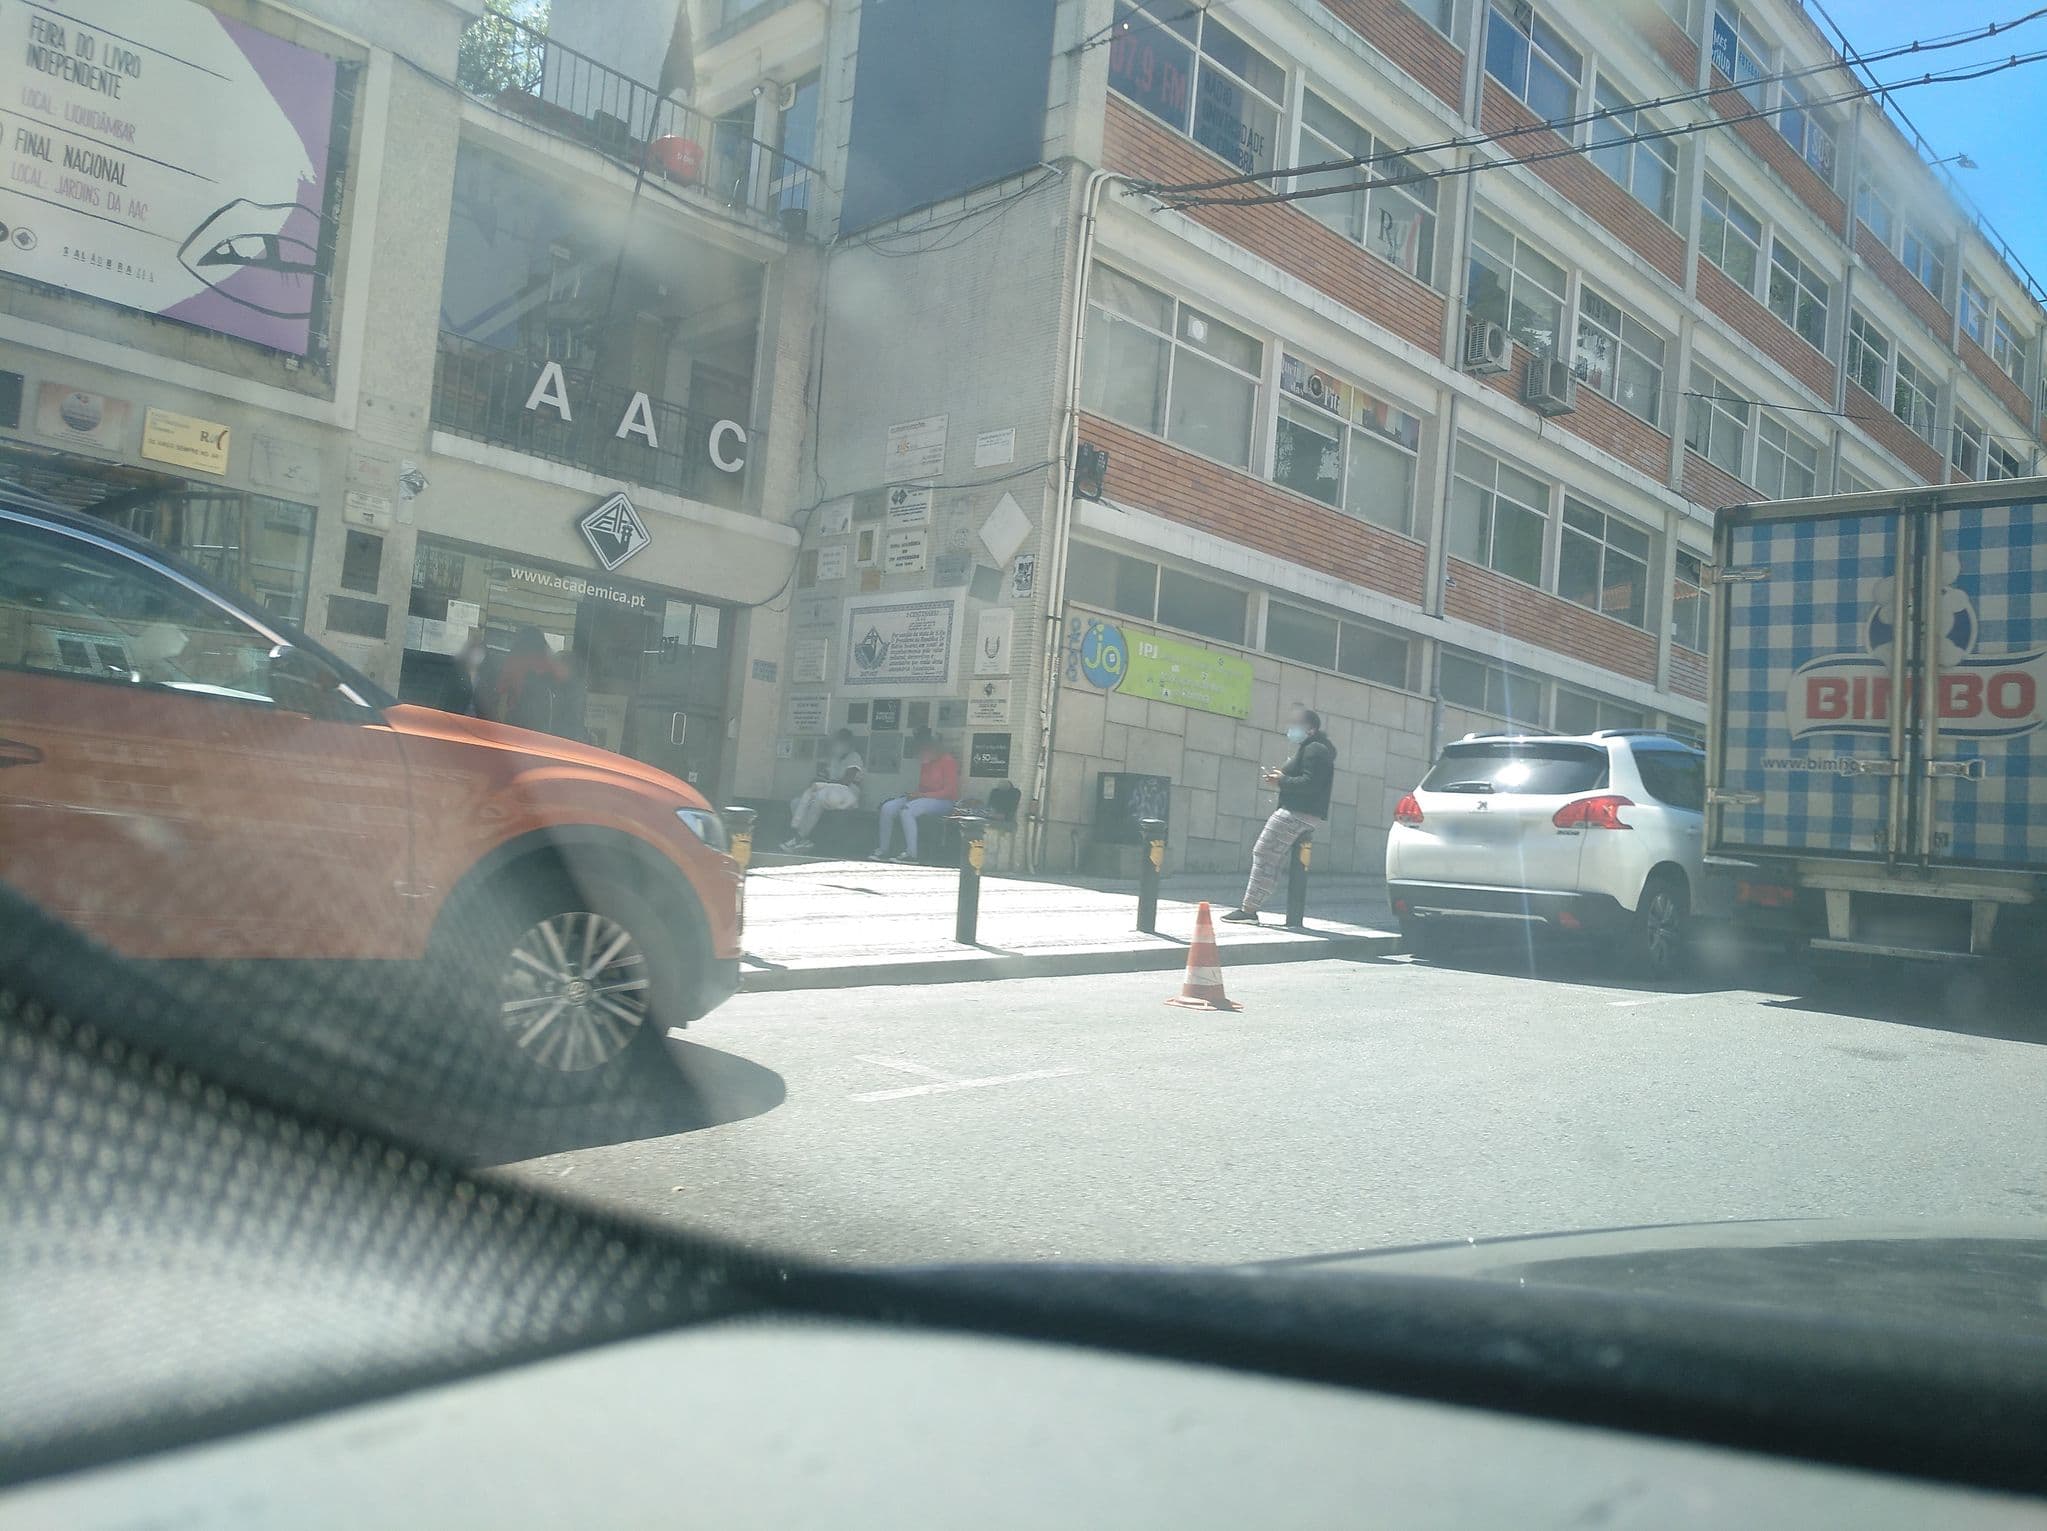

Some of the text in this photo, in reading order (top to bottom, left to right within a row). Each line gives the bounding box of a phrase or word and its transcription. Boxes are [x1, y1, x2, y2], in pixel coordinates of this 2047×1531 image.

[26, 42, 122, 100] INDEPENDENTE
[30, 15, 141, 79] FEIRA DO LIVRO
[15, 128, 128, 188] FINAL NACIONAL
[55, 176, 100, 207] JARDINS
[107, 191, 121, 213] DA
[128, 199, 149, 220] AAC
[510, 567, 647, 608] www.academica.pt
